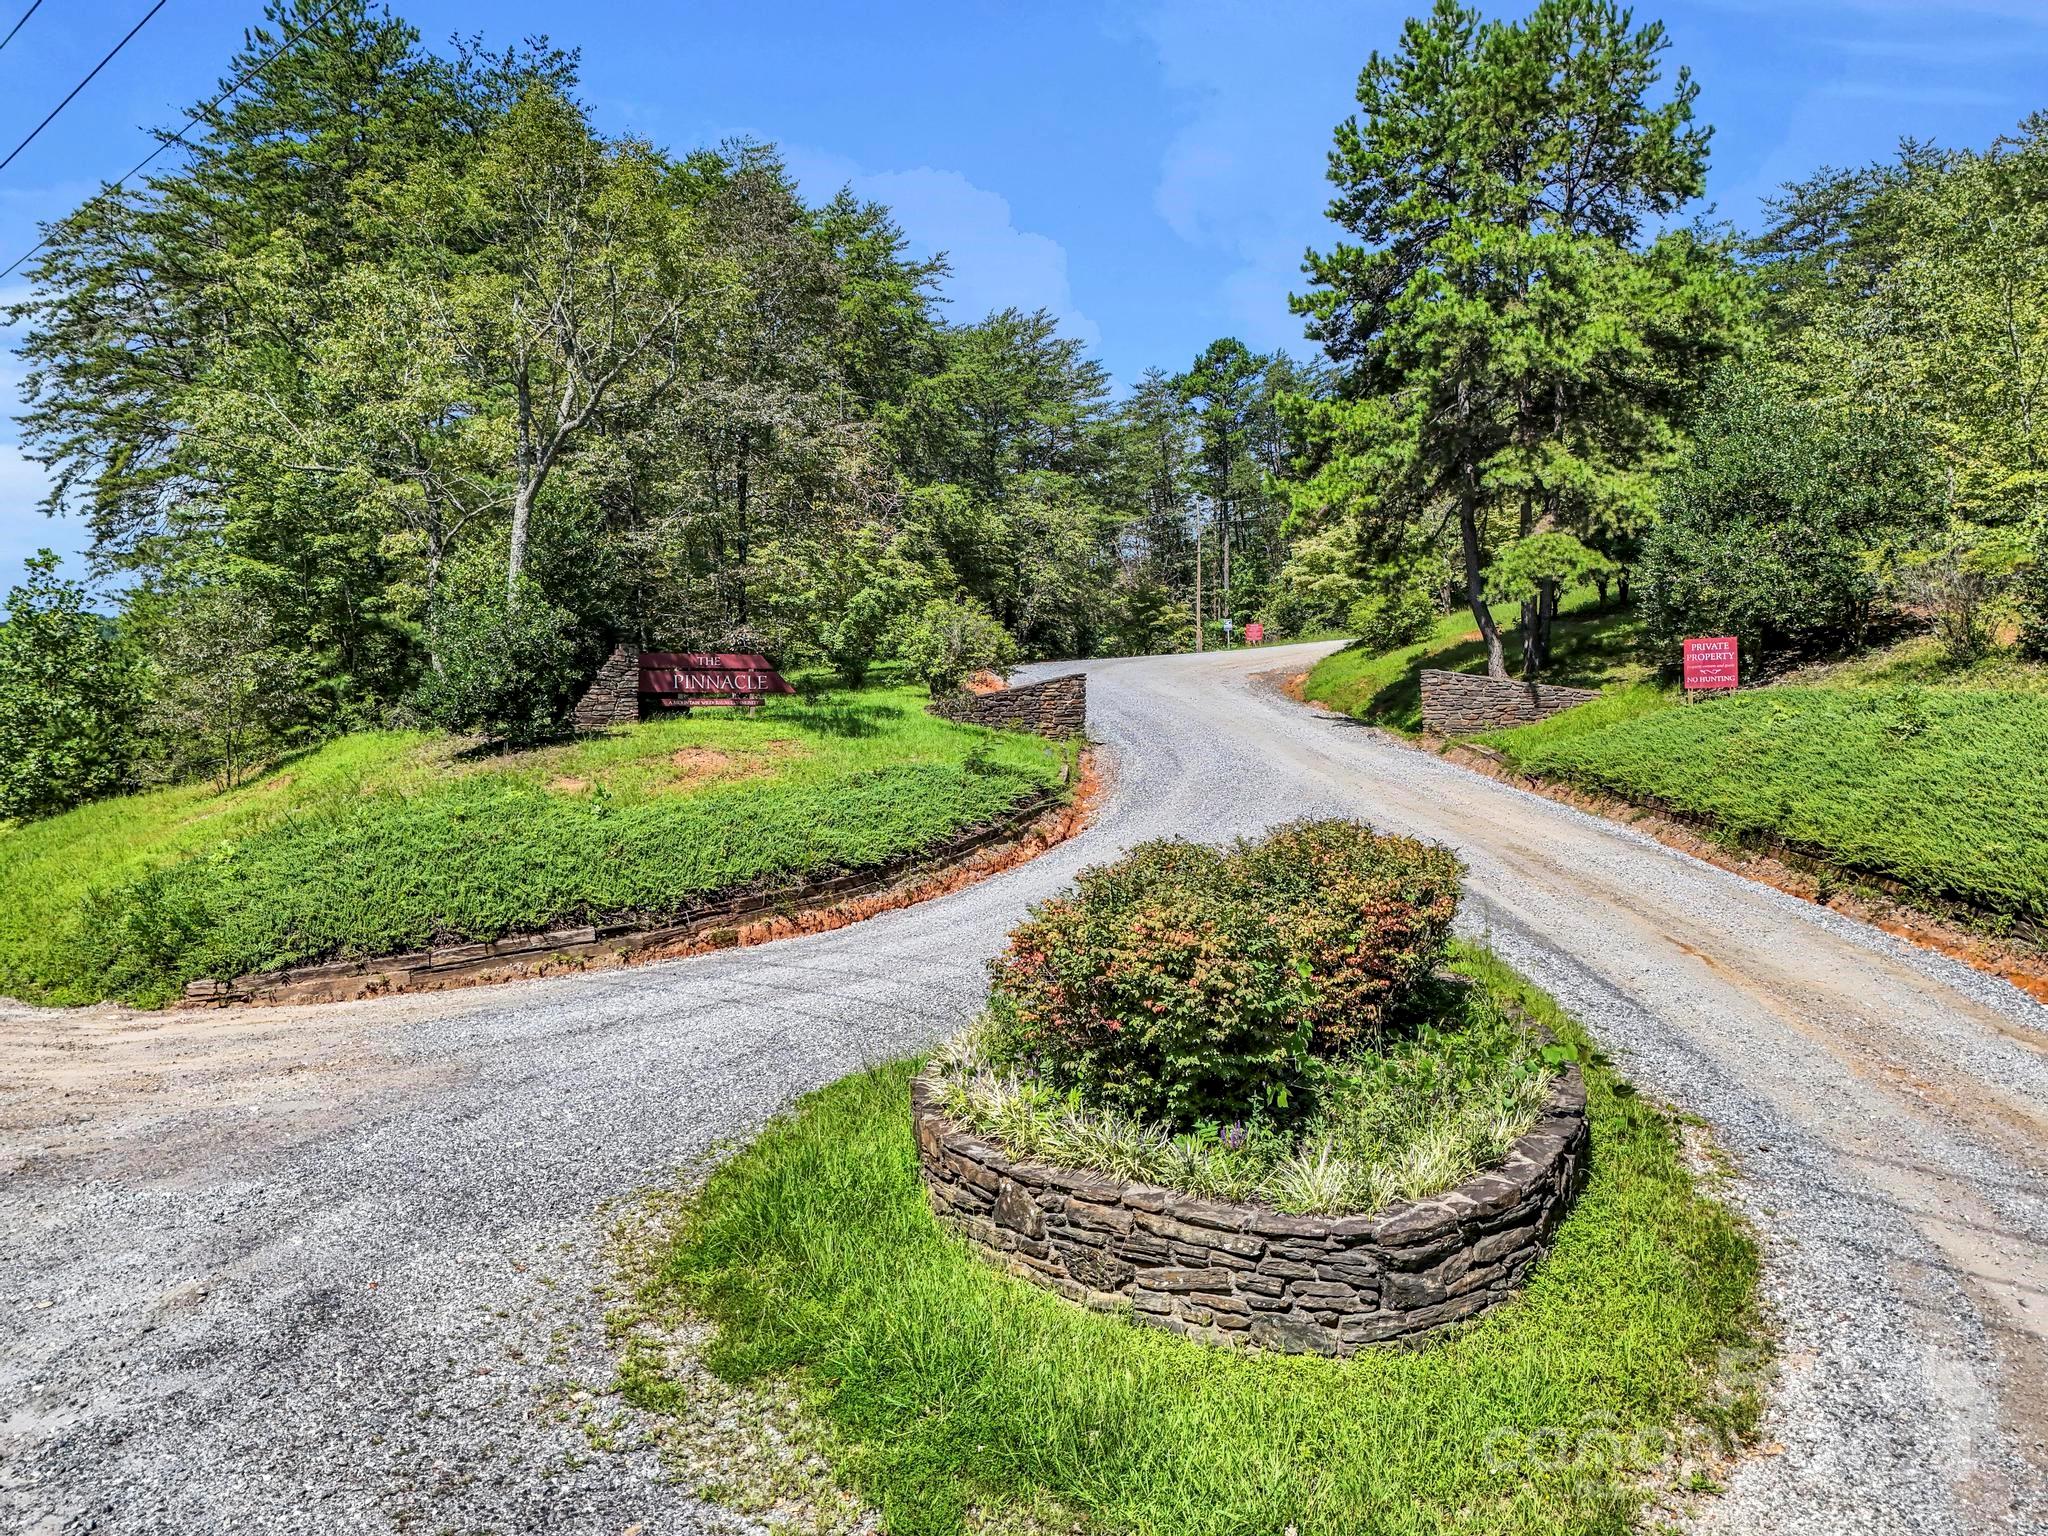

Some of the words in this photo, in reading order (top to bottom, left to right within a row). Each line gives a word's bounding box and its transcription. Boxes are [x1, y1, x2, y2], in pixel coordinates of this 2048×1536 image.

[1692, 642, 1729, 651] PRIVATE
[697, 656, 721, 666] THE
[1686, 652, 1735, 661] PROPERTY
[674, 674, 769, 689] PINNACLE
